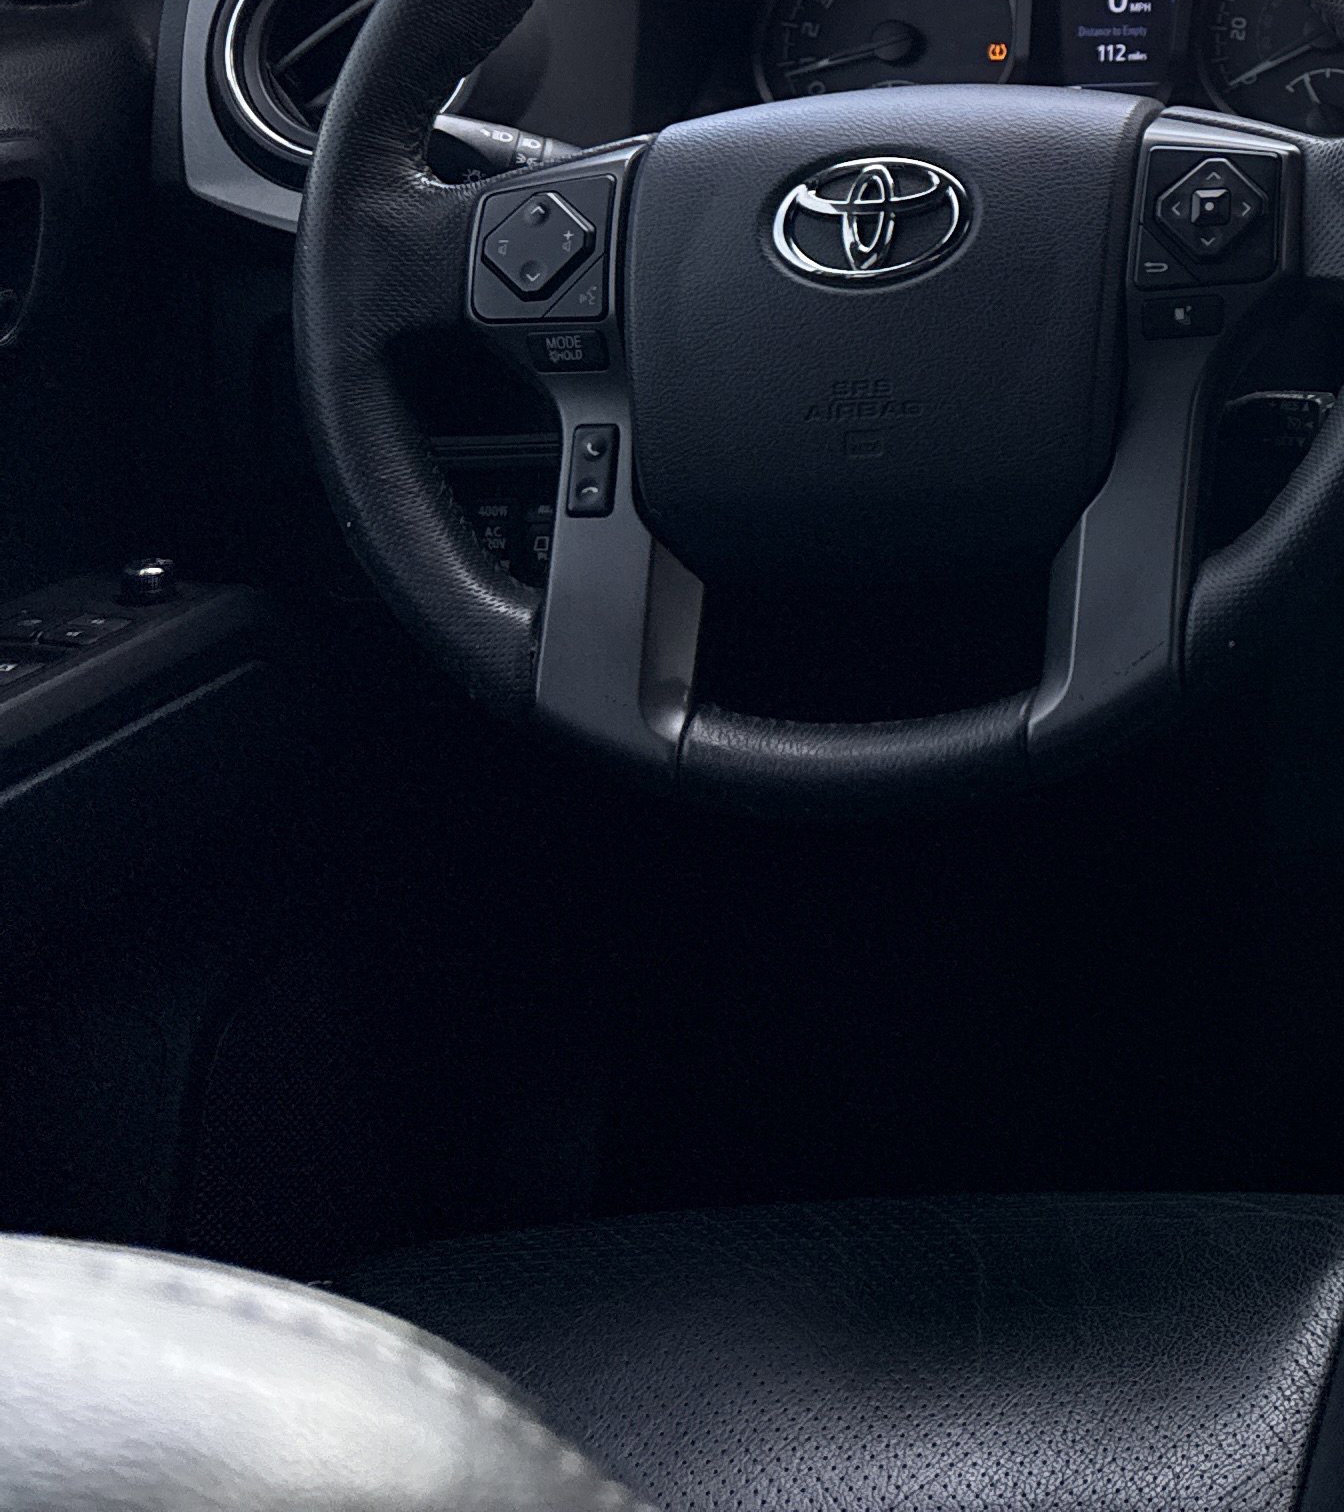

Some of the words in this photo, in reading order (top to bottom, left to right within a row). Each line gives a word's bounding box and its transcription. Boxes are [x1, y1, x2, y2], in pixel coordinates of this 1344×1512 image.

[1097, 43, 1127, 62] 112
[545, 334, 584, 350] MODE
[559, 348, 584, 361] HOLD
